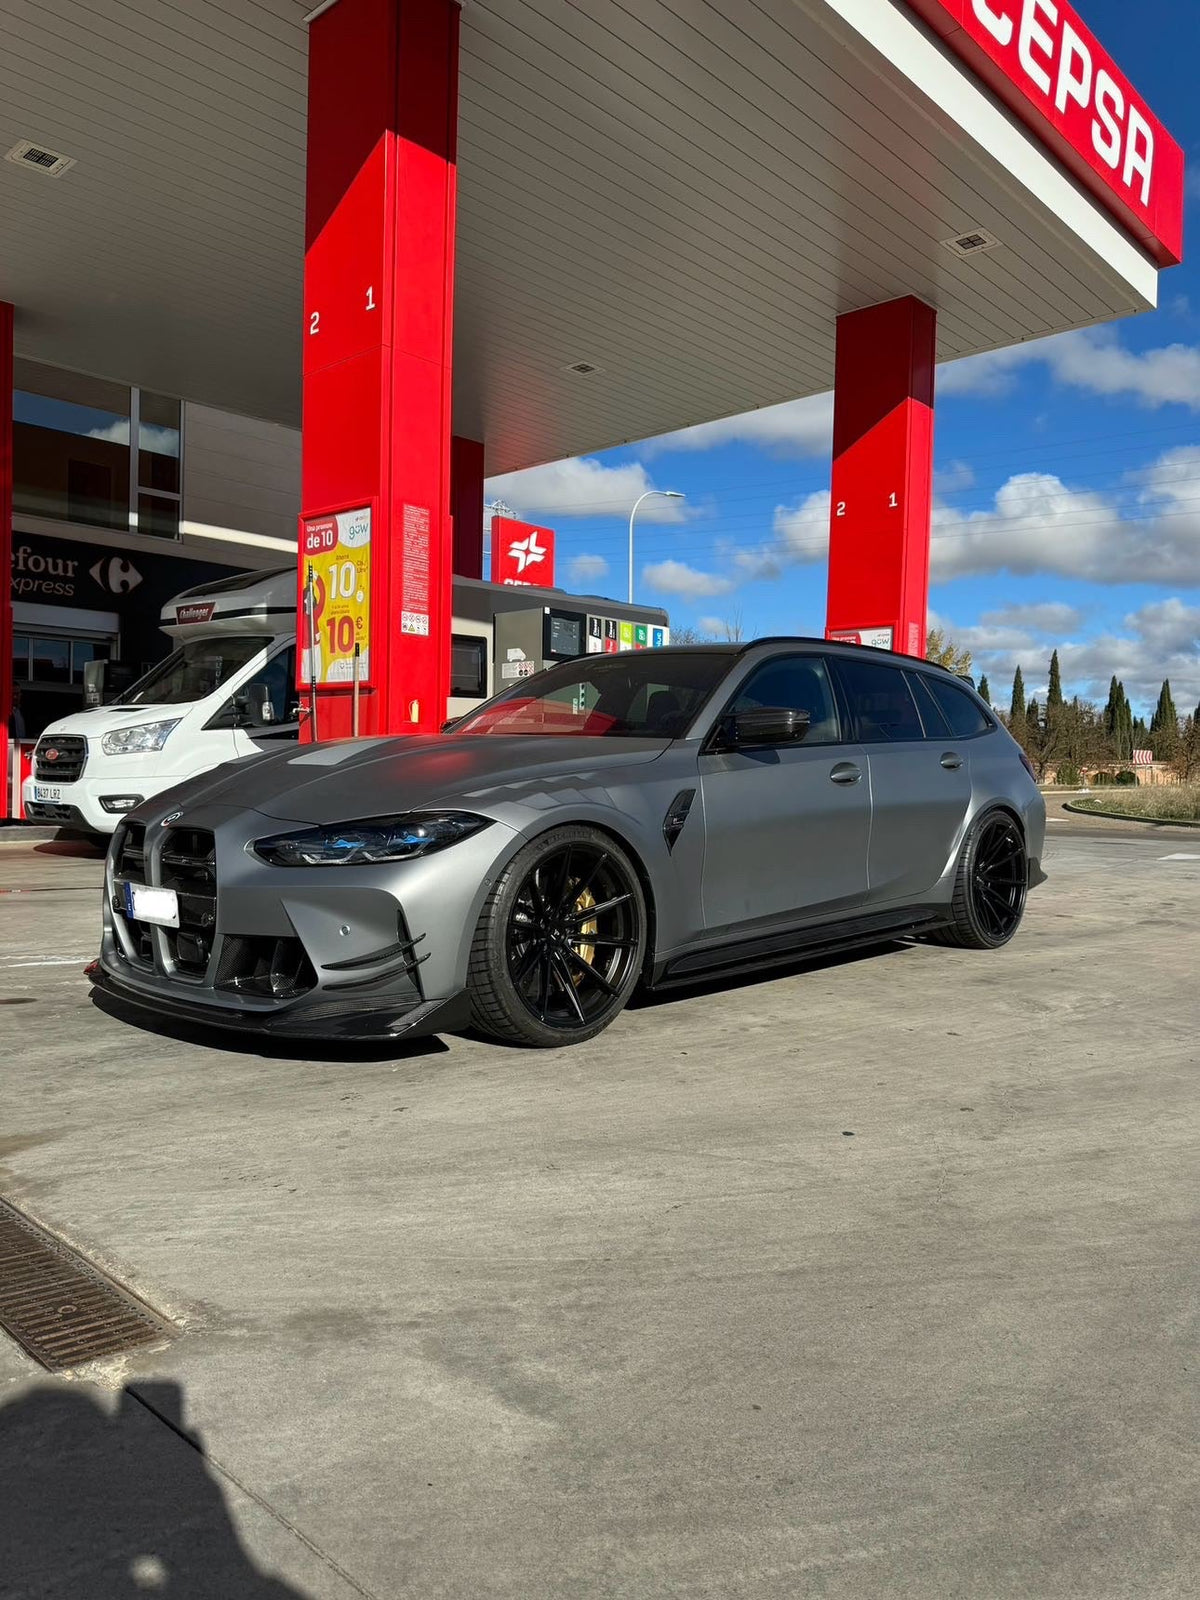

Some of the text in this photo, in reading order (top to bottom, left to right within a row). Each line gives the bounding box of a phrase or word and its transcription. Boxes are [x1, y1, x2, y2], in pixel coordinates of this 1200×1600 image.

[310, 286, 376, 335] 2 1
[837, 492, 898, 517] 2 1
[307, 530, 333, 549] de 10
[328, 561, 356, 600] 10
[326, 616, 363, 654] 10 €
